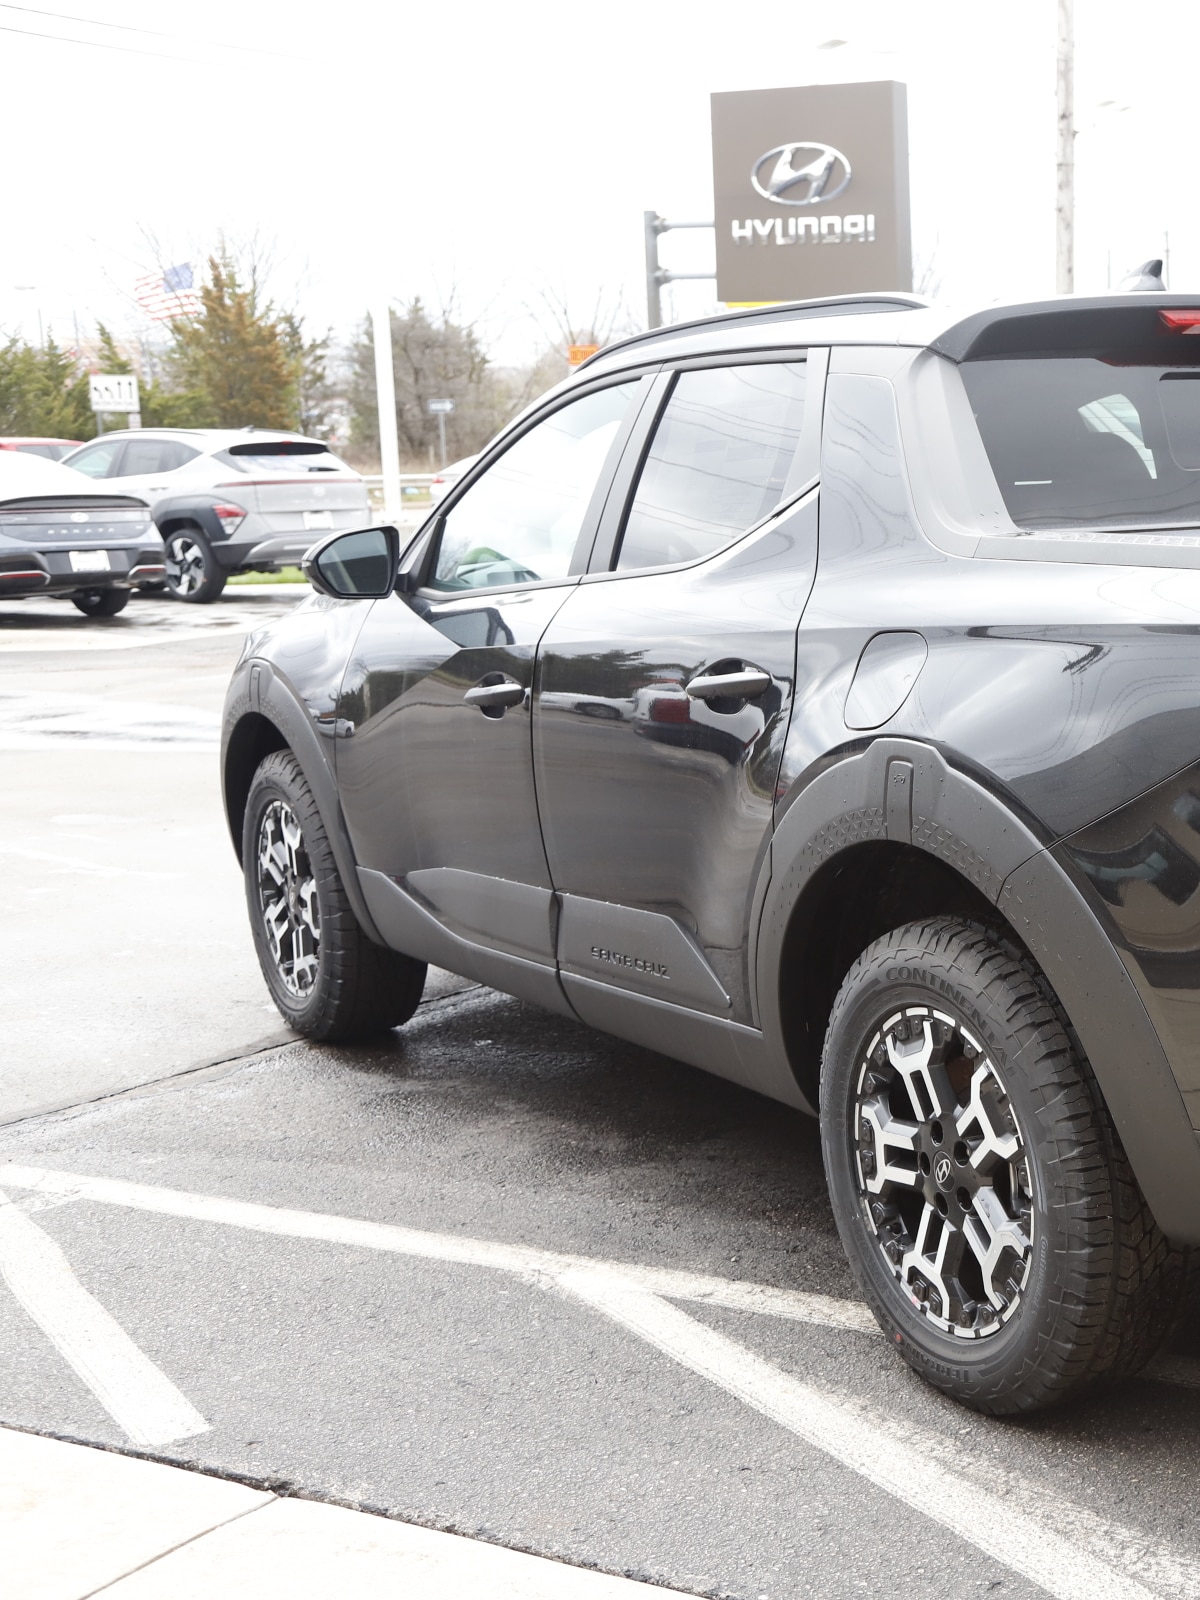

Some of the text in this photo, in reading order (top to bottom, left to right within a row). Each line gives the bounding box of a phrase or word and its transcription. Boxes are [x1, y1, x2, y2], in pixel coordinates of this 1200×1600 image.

[732, 214, 875, 246] HYUNDAI
[591, 946, 670, 979] SANTA CRUZ
[885, 966, 1016, 1077] CONTINENTAL
